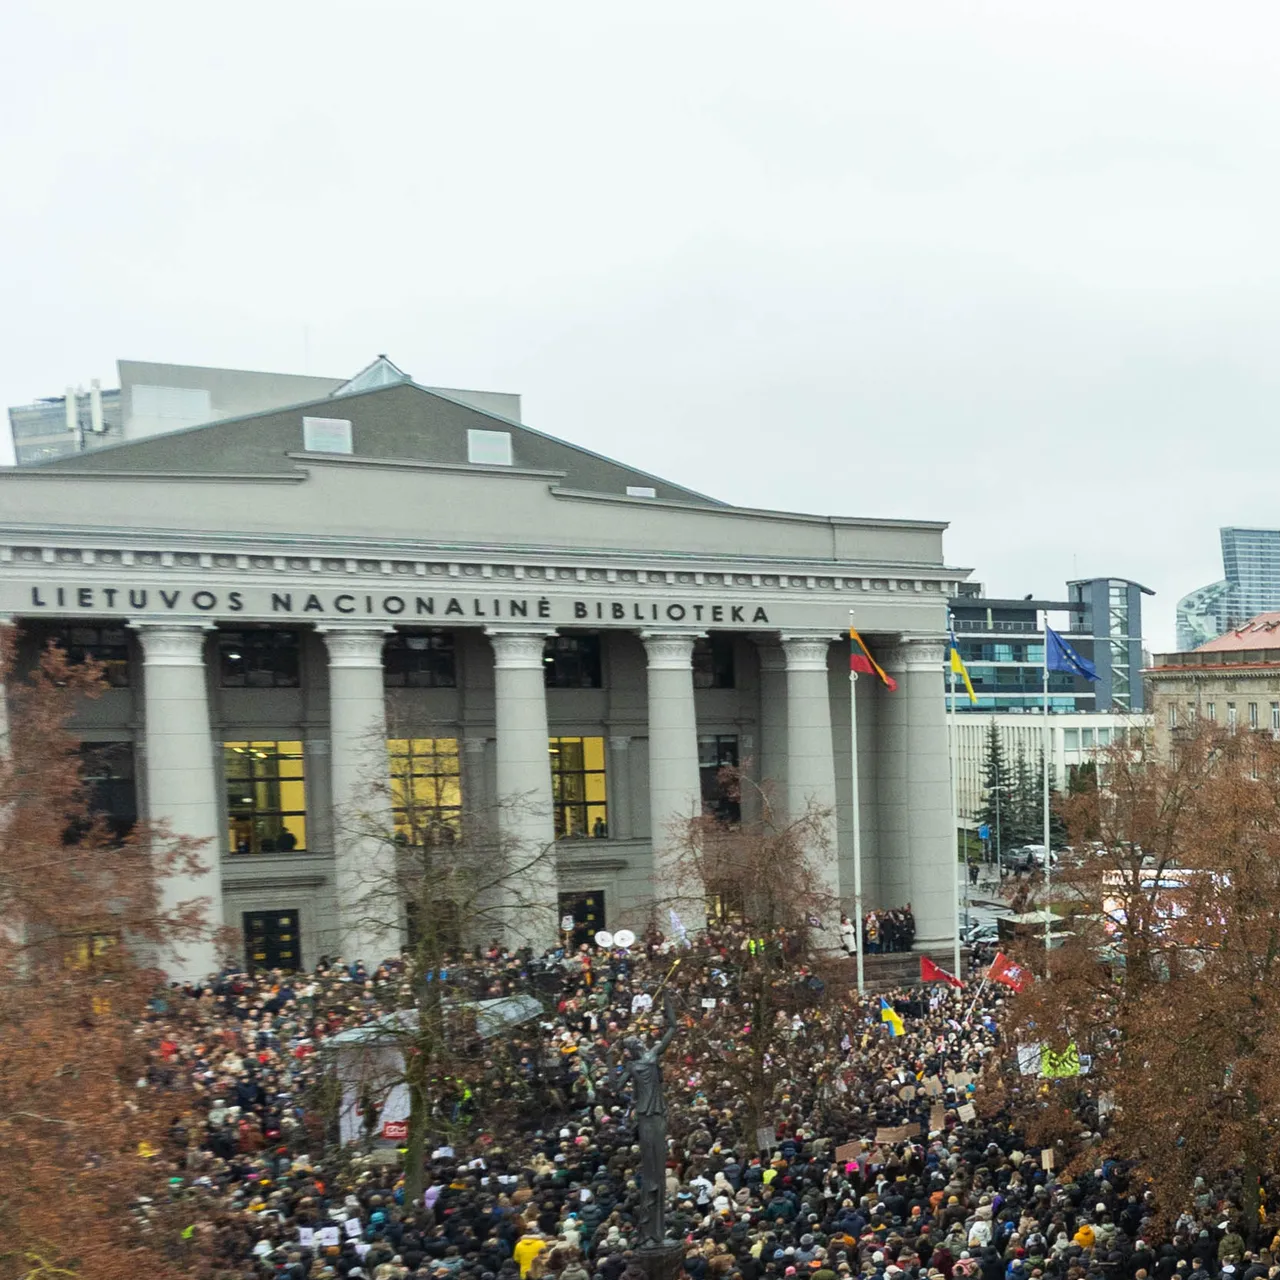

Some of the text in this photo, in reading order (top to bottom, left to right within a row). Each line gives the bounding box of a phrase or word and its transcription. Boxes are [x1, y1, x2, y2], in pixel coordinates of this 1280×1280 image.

[32, 586, 770, 623] LIETUVOS NACIONALINĖ BIBLIOTEKA
